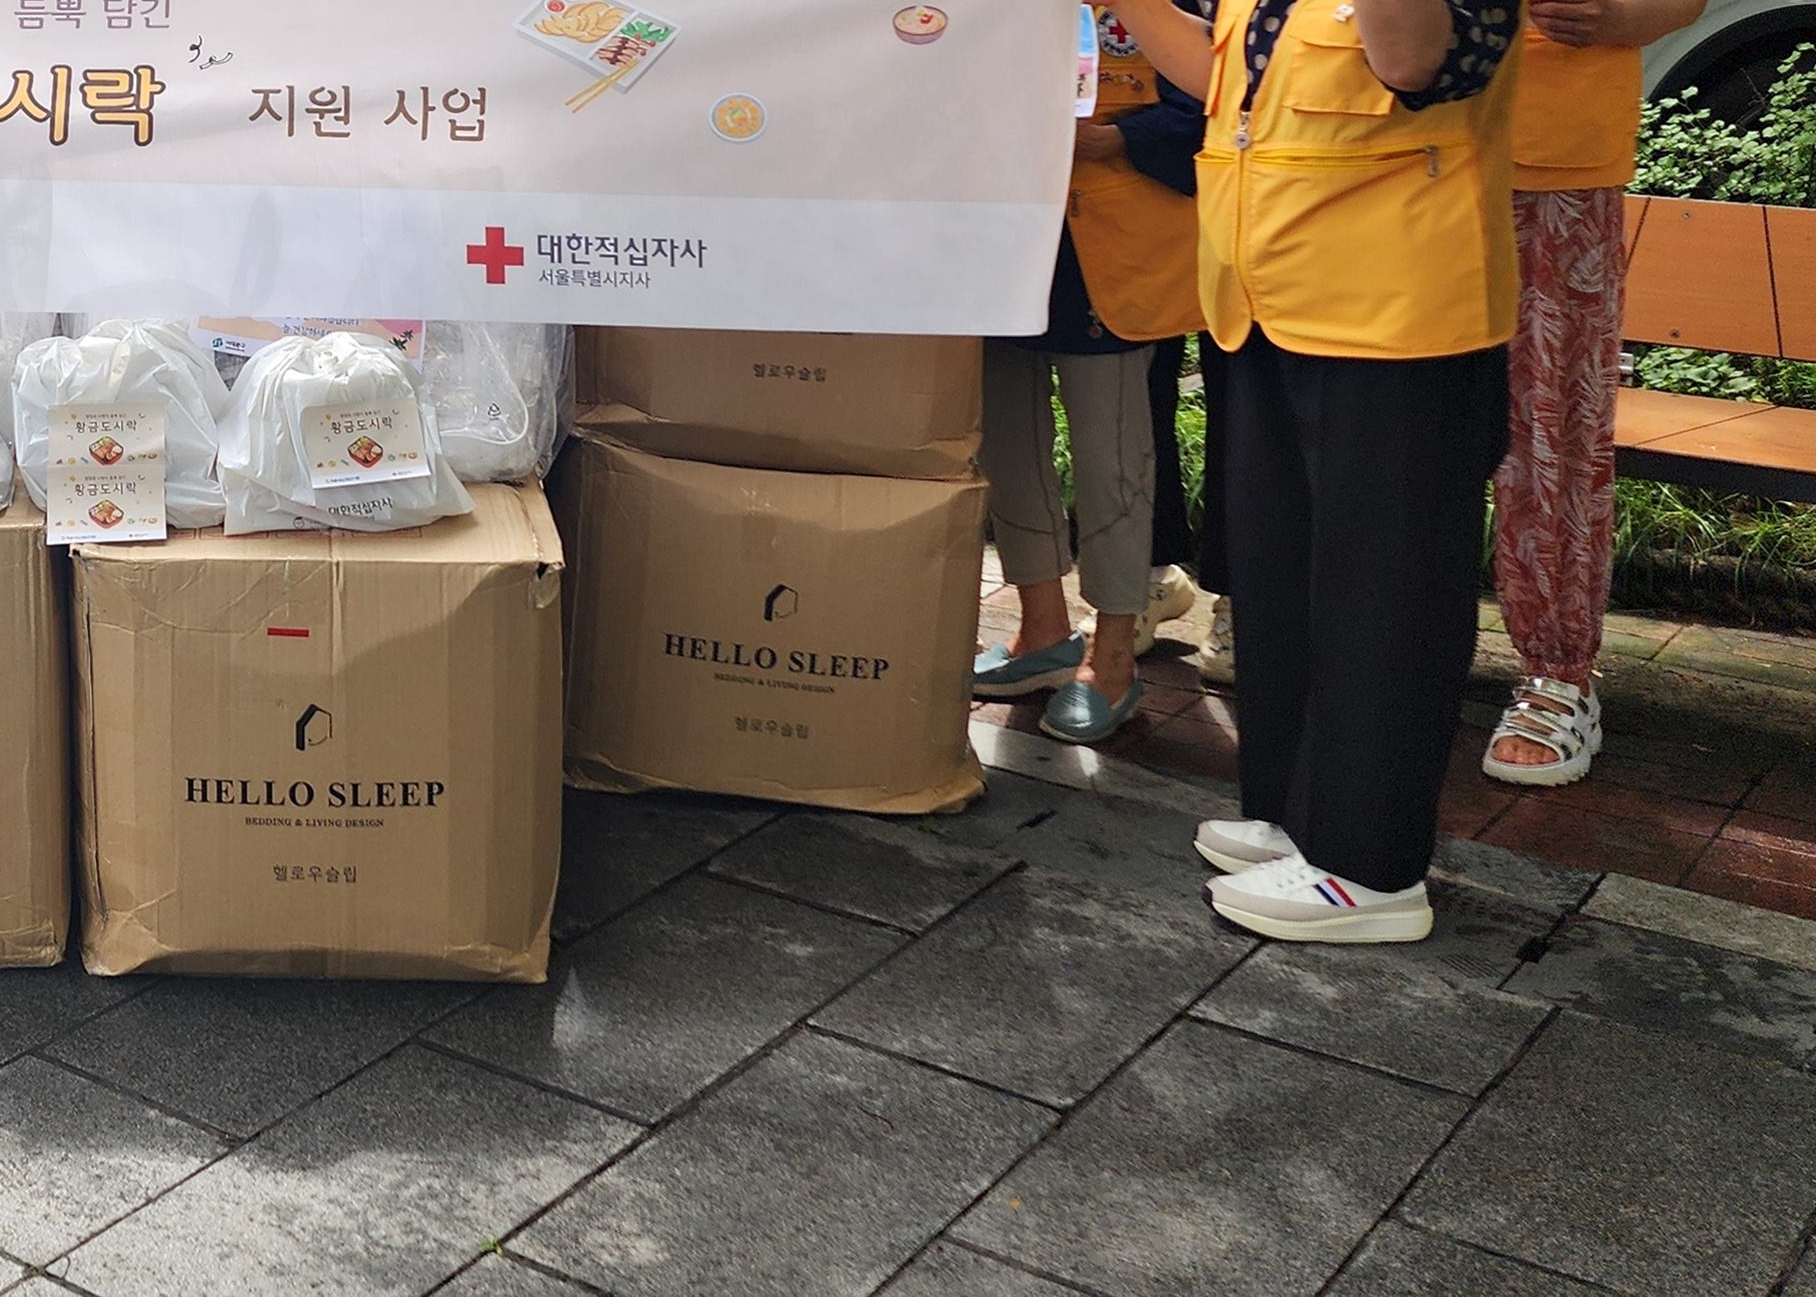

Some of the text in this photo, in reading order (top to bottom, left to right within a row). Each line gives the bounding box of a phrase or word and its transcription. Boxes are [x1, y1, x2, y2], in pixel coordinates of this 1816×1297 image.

[248, 84, 353, 141] 지원
[384, 86, 489, 143] 사업
[536, 232, 708, 270] 대한적십자사
[538, 270, 651, 290] 서울특별시지사
[664, 631, 890, 681] HELLO SLEEP
[184, 776, 445, 809] HELLO SLEEP
[245, 816, 384, 829] BEDDING & LIVING DESIGN
[273, 863, 357, 884] 헬로우슬립
